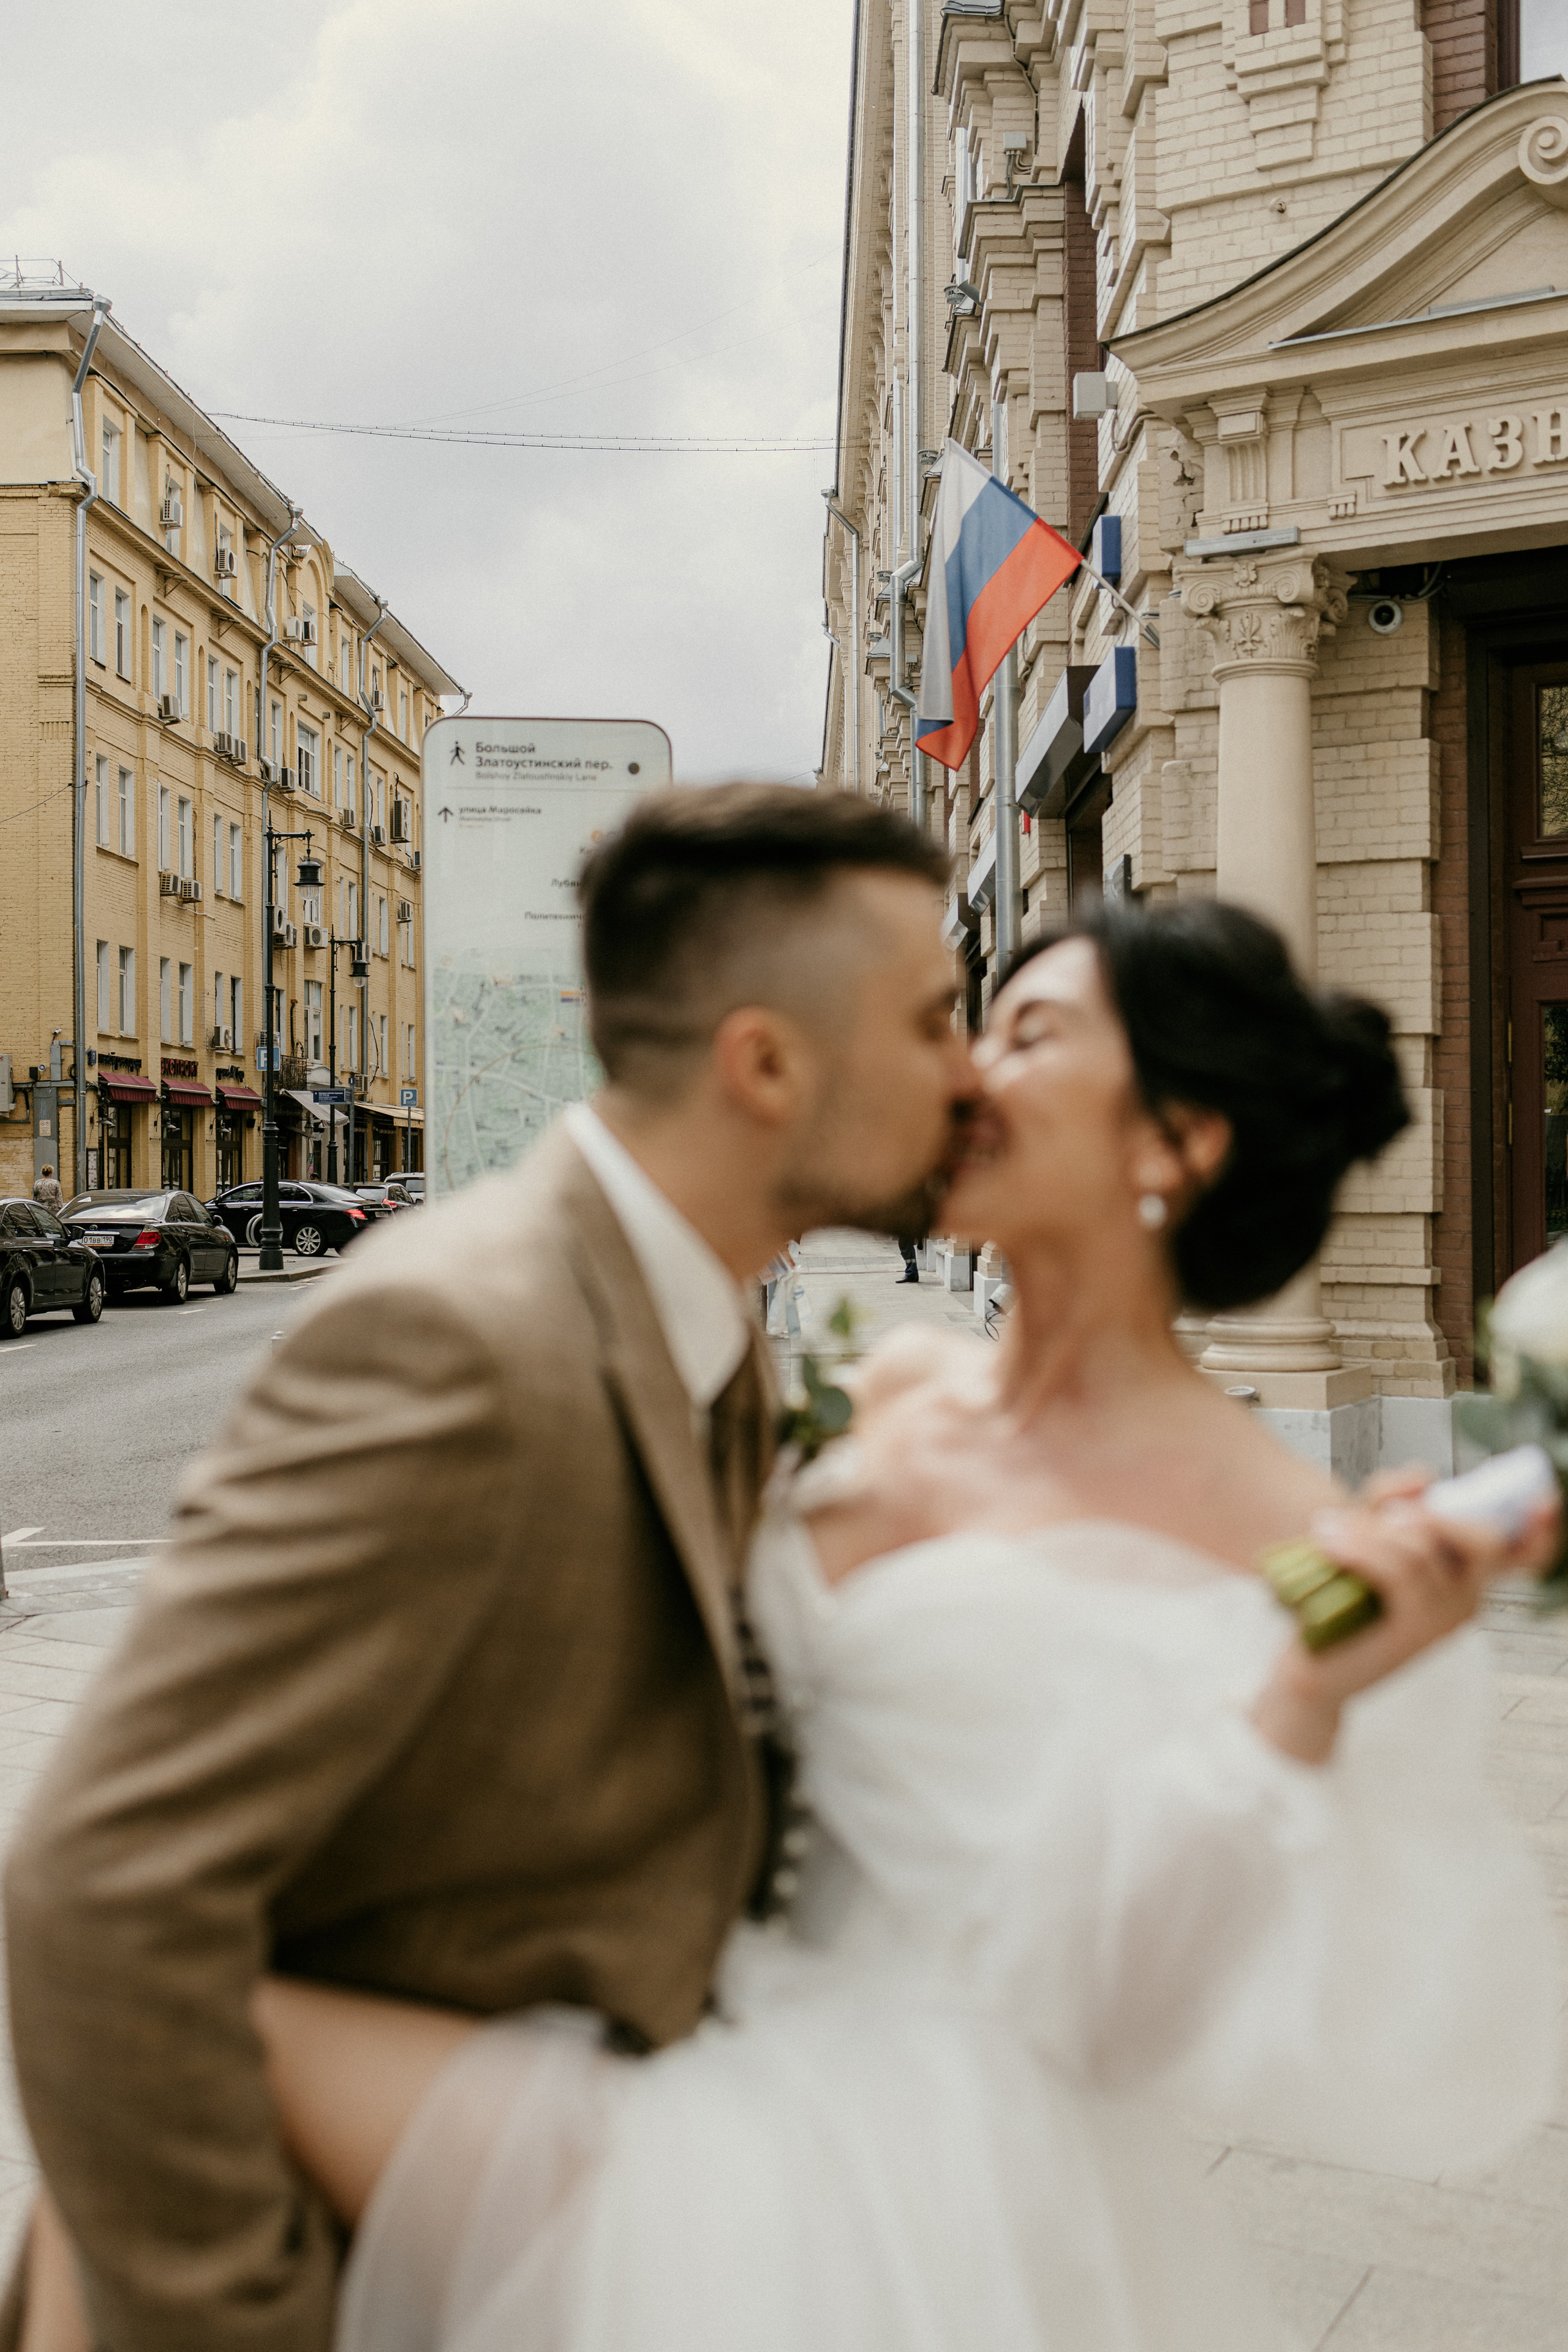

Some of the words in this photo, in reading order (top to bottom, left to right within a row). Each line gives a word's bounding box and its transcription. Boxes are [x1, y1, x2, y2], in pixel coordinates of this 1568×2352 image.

[1382, 406, 1568, 488] КАЗН
[475, 742, 536, 753] Большой
[475, 756, 581, 770] Златоустинский
[585, 761, 614, 771] пер.
[489, 805, 541, 814] Маросейка
[551, 878, 581, 888] Лубян
[403, 1091, 413, 1104] P
